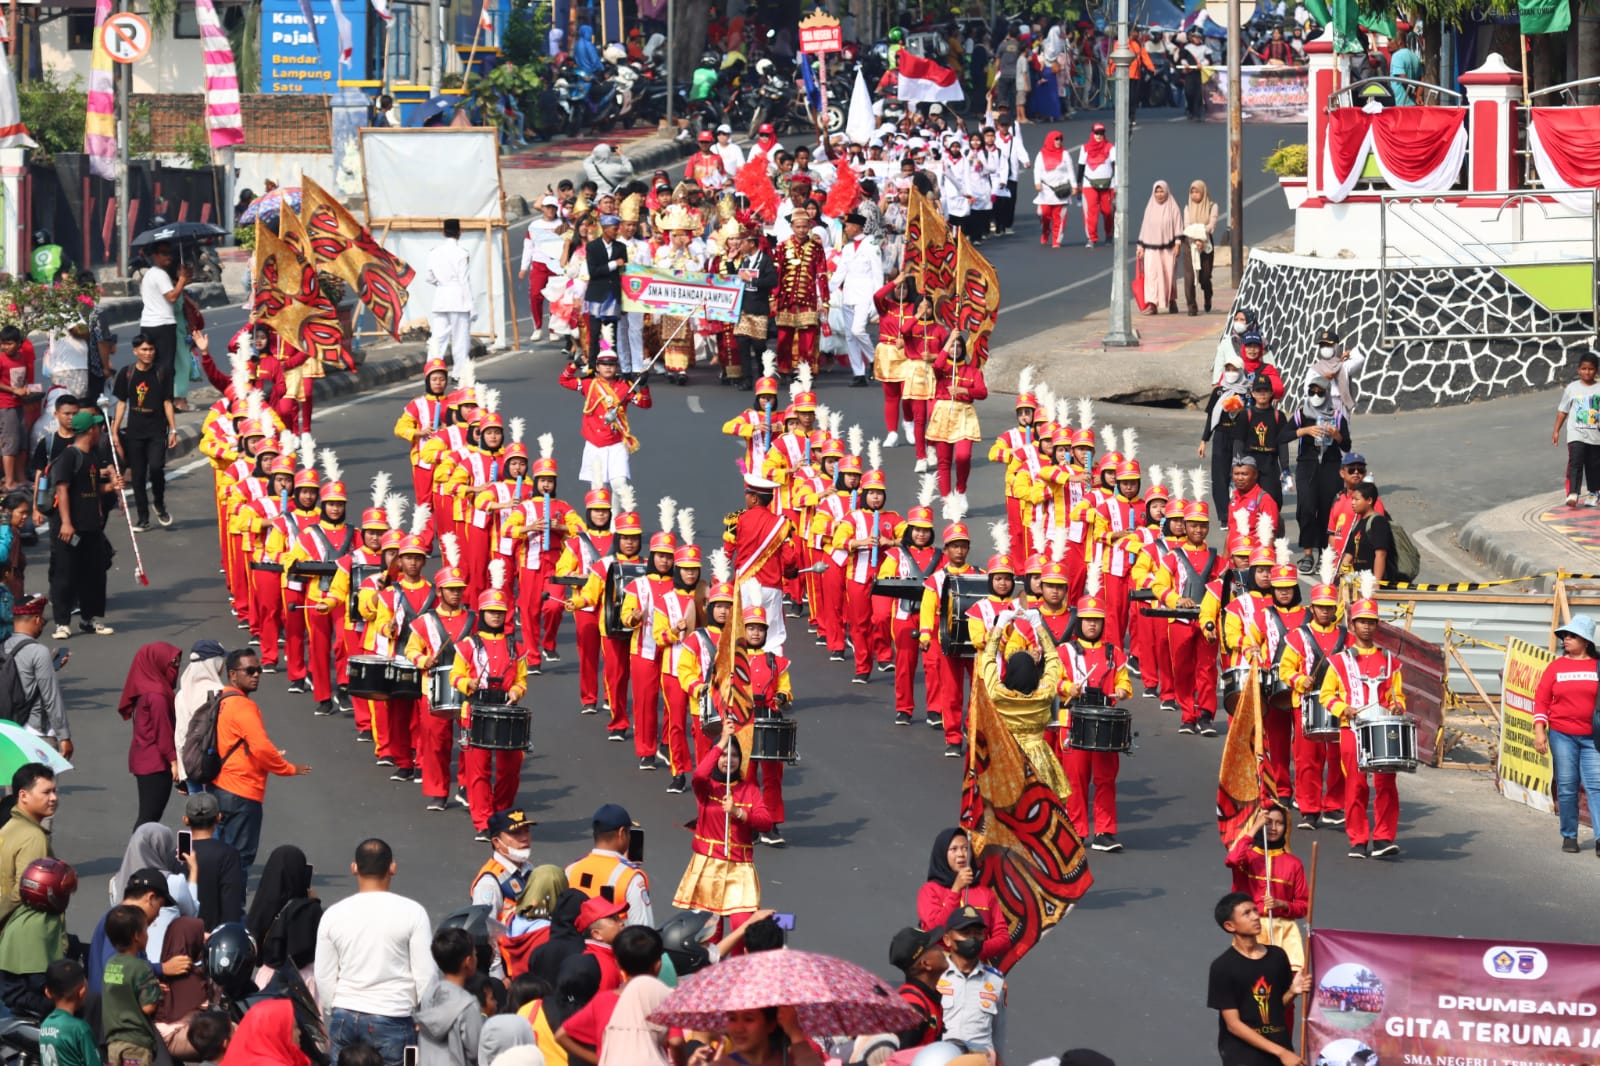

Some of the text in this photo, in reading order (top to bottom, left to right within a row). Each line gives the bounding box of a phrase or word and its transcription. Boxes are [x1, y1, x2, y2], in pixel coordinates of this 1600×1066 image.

[272, 54, 318, 64] Bandar
[272, 69, 332, 80] Lampung
[272, 82, 303, 92] Satu
[648, 285, 663, 297] SMA
[664, 287, 669, 297] N
[678, 288, 704, 300] BANDAR
[1438, 995, 1597, 1017] DRUMBAND
[1385, 1017, 1452, 1040] GITA
[1458, 1020, 1573, 1048] TERUNA
[1404, 1054, 1433, 1065] SMA
